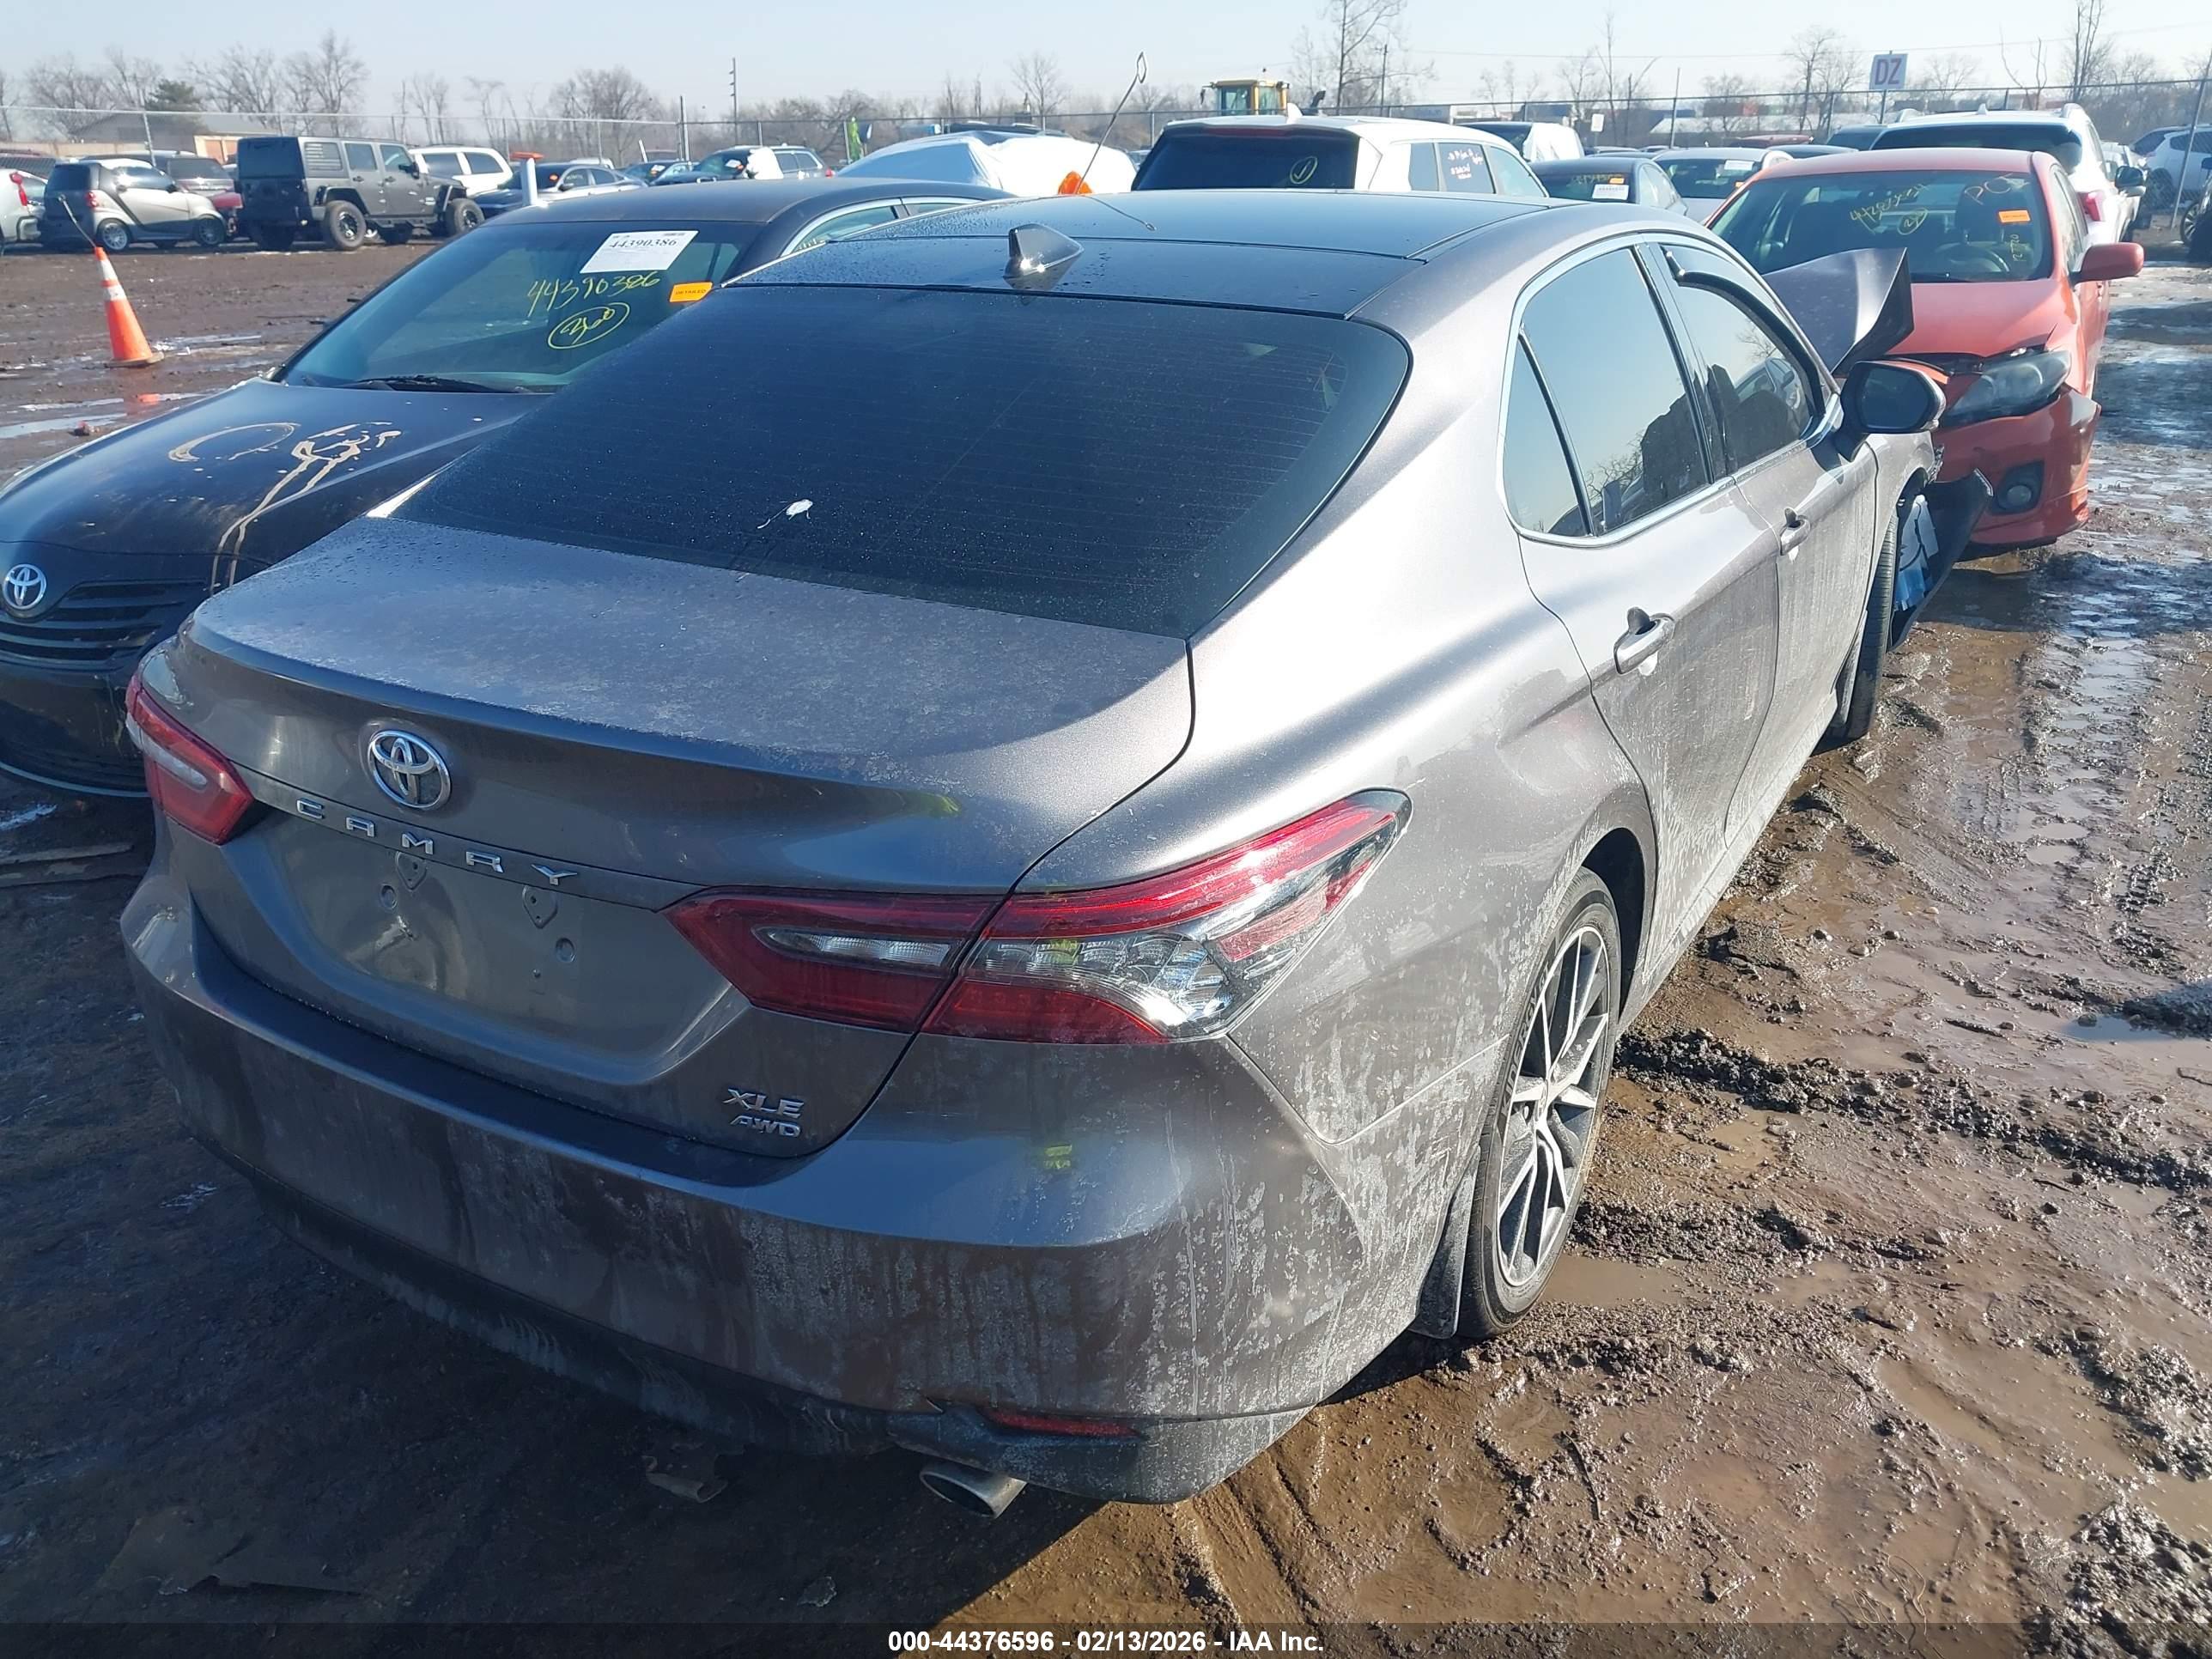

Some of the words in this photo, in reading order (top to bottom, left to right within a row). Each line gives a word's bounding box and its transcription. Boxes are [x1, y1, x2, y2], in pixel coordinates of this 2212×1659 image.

[609, 239, 678, 248] 44390386
[527, 270, 660, 318] 44390386
[297, 798, 578, 886] CAMRY
[722, 1088, 805, 1118] XLE
[730, 1115, 801, 1138] AWD
